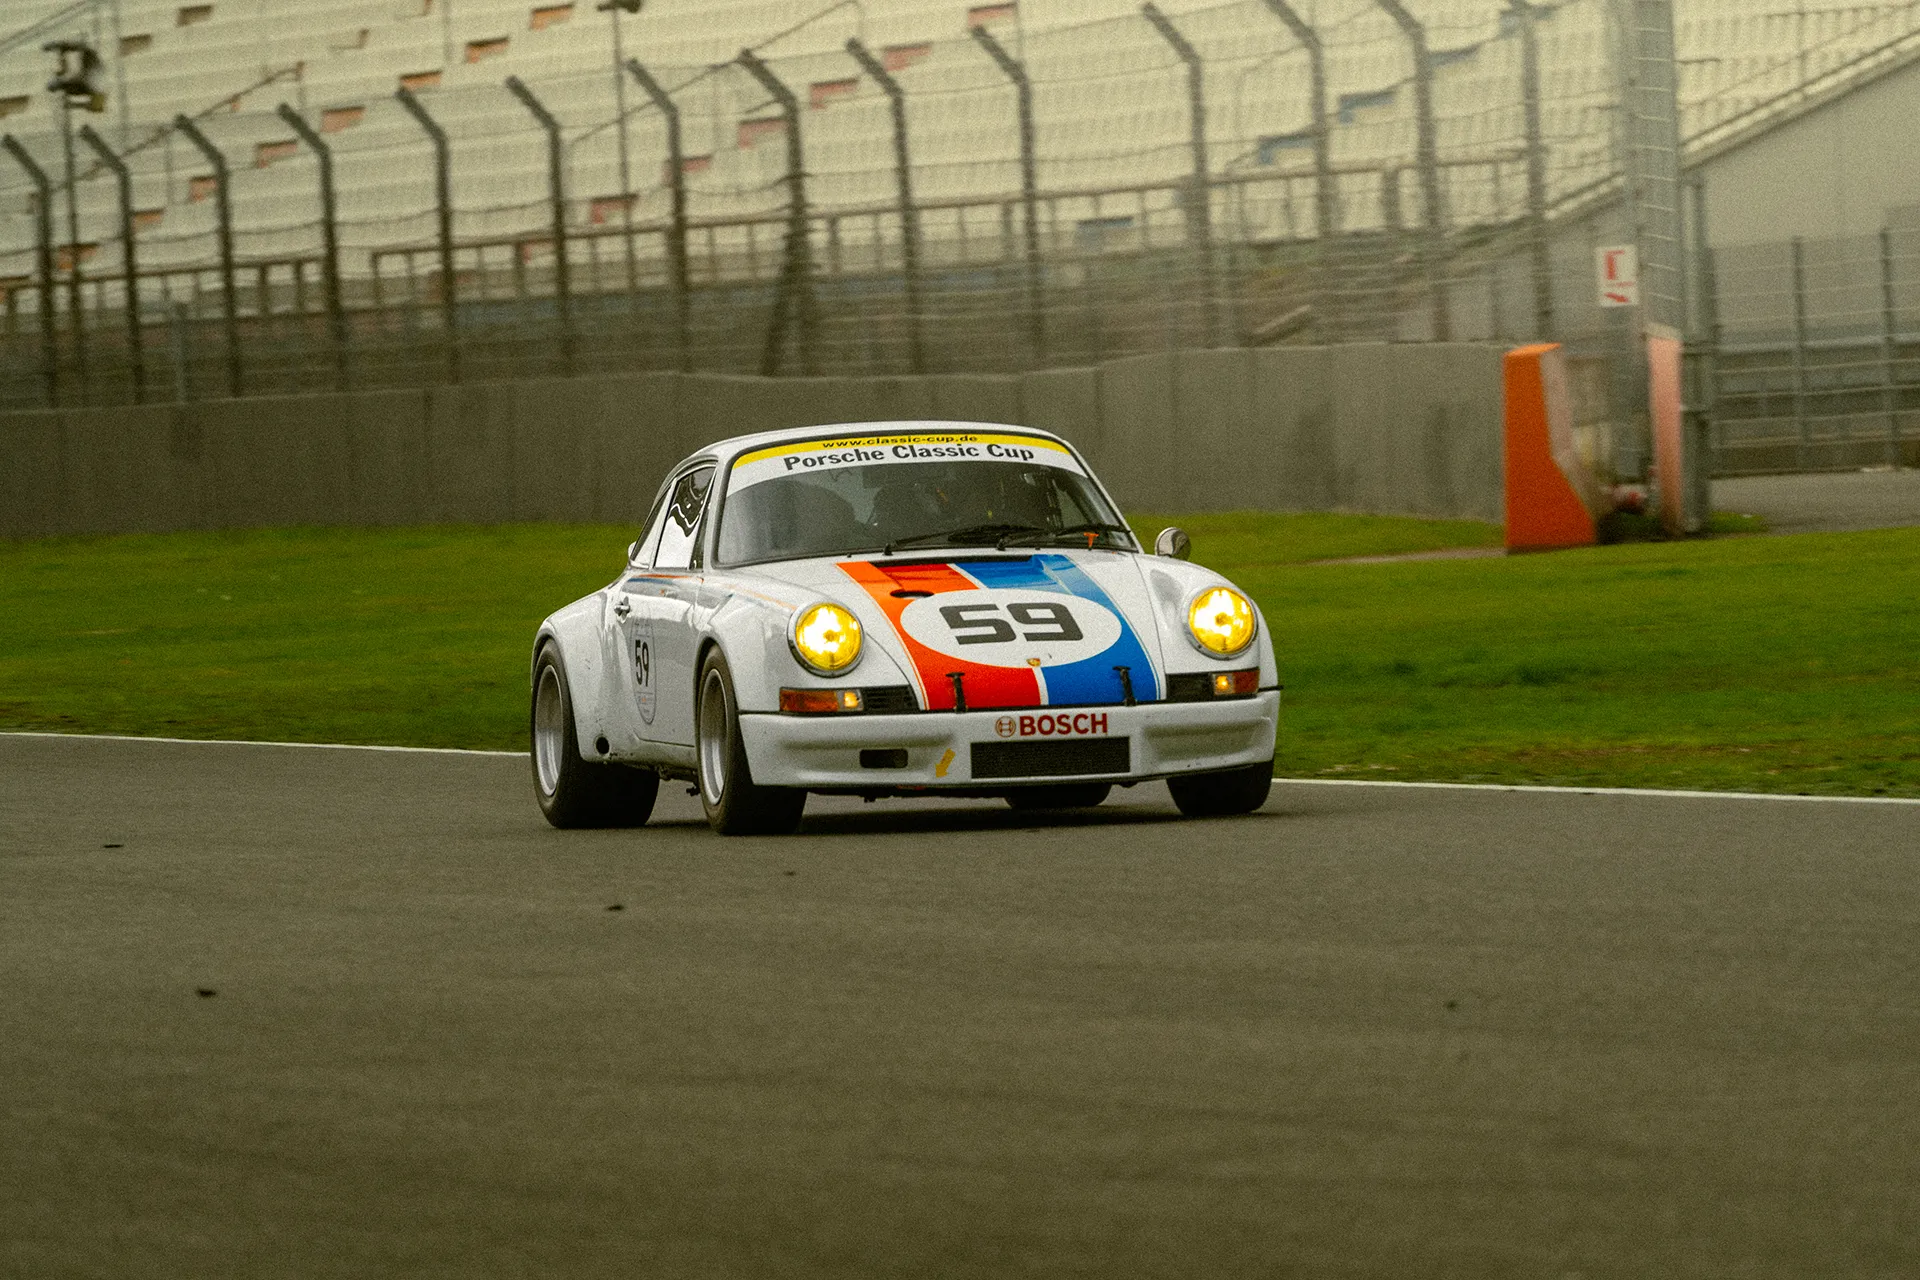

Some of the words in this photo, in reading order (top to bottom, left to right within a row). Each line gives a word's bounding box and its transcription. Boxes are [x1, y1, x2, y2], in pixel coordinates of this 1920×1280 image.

[822, 435, 978, 448] www.classic-cup.de
[783, 448, 885, 471] Porsche
[891, 442, 980, 460] Classic
[986, 443, 1035, 461] Cup
[939, 602, 1084, 645] 59
[634, 639, 650, 688] 59
[1019, 712, 1108, 737] BOSCH
